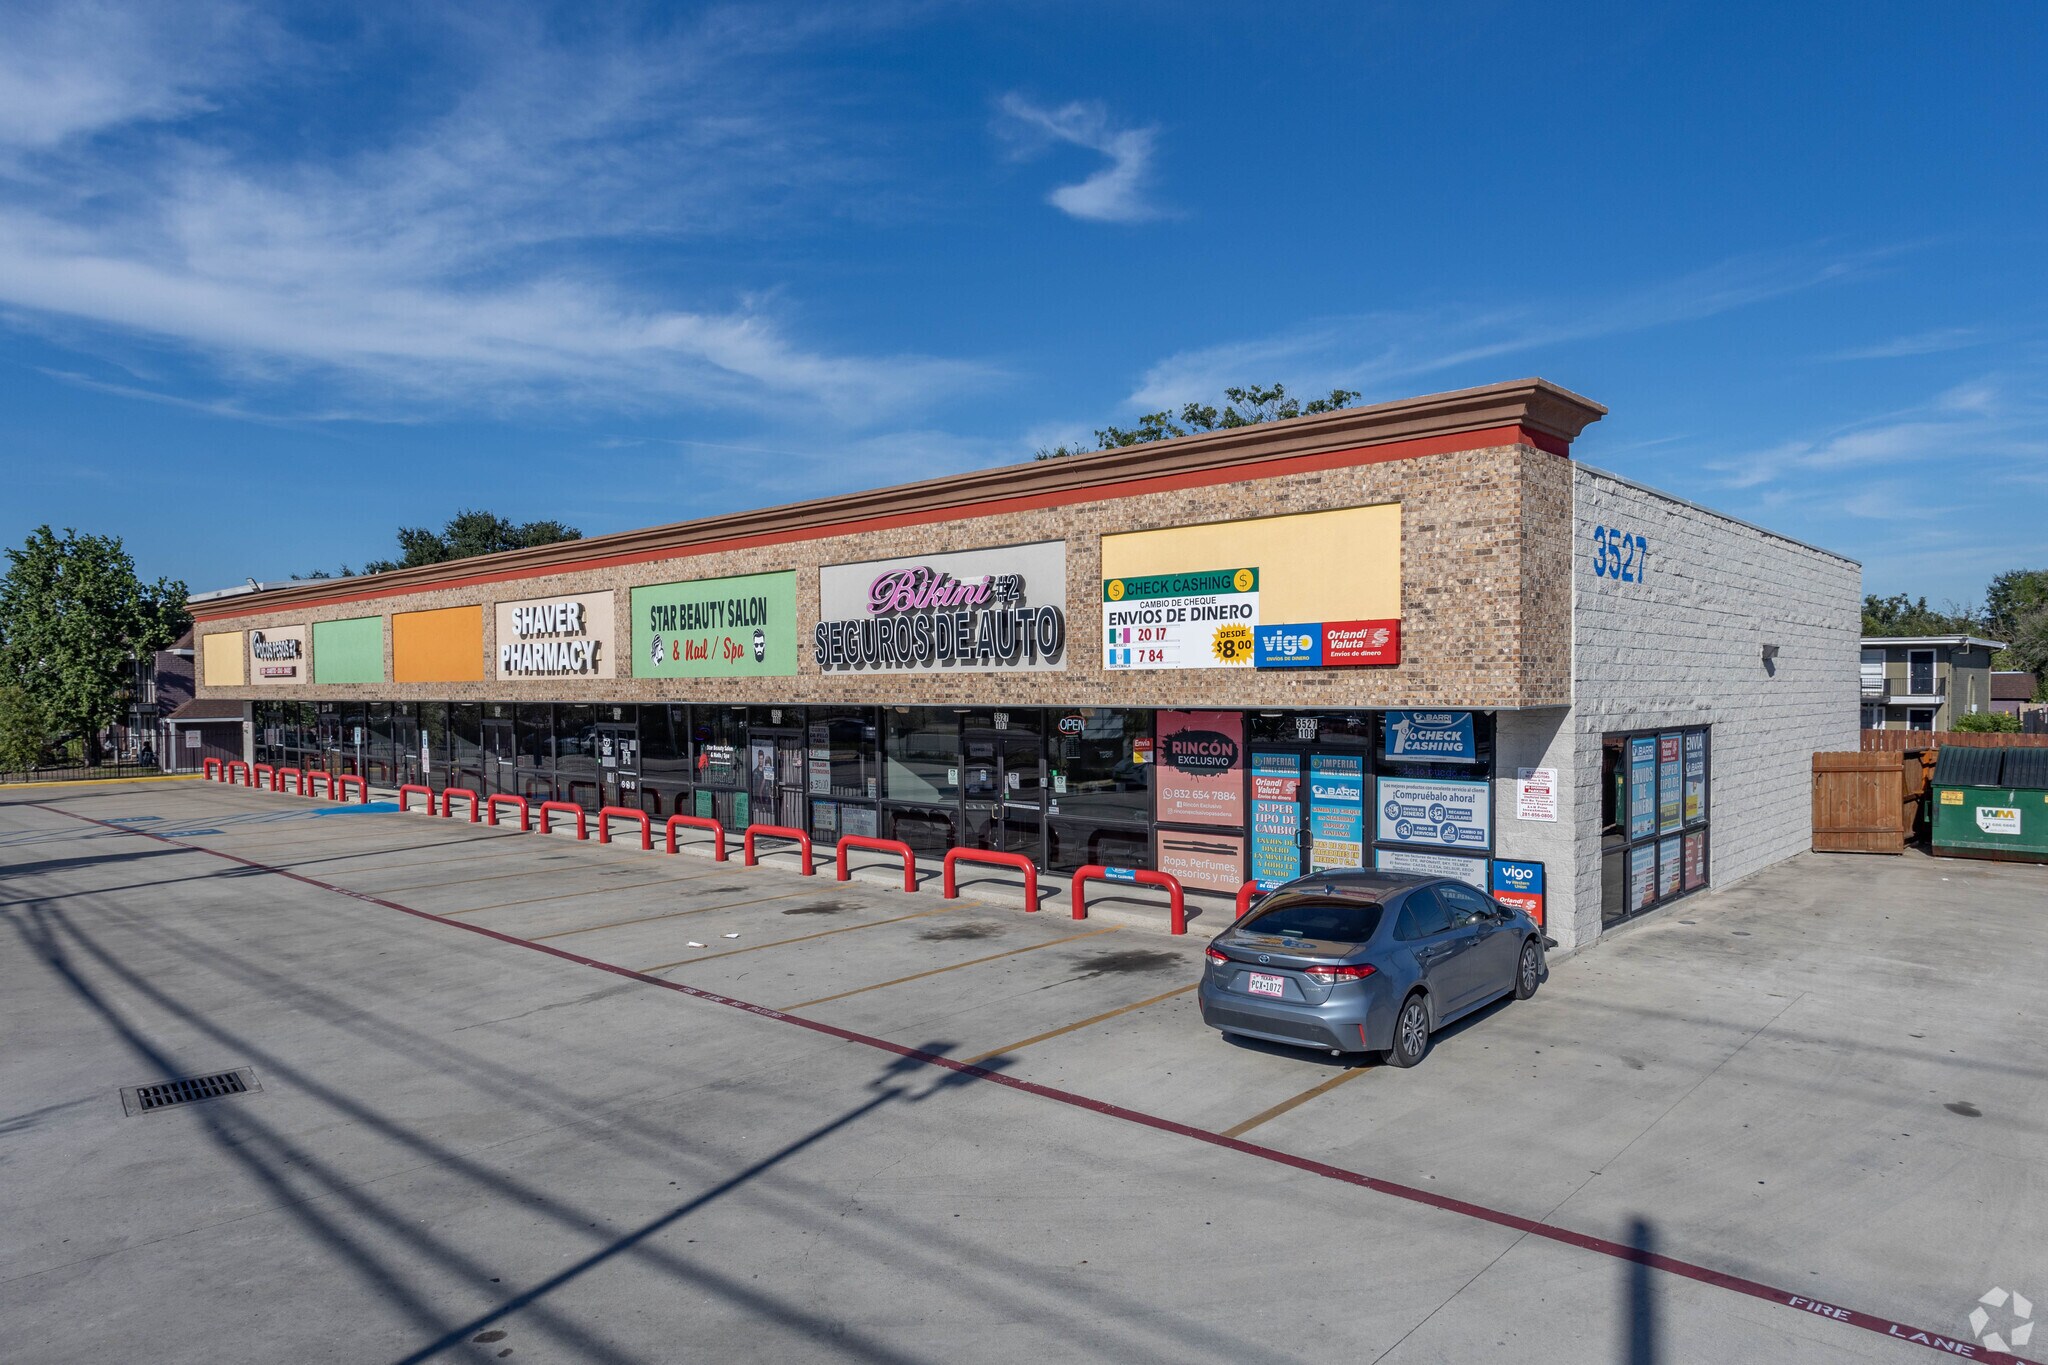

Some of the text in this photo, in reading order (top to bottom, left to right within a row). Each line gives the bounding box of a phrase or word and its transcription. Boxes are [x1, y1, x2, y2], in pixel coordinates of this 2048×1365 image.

[1593, 525, 1647, 584] 3527
[866, 565, 1019, 614] Bikini #2
[1127, 575, 1231, 596] CHECK CASHING
[1140, 596, 1216, 609] CAMBIO DE CHEQUE
[511, 602, 580, 635] SHAVER
[650, 596, 767, 631] STAR BEAUTY SALON
[1109, 603, 1253, 626] ENVIOS DE DINERO
[814, 605, 1059, 665] SEGUROS DE AUTO
[1220, 630, 1246, 639] DESDE
[1327, 629, 1368, 640] Orlandi
[1263, 630, 1313, 655] vigo
[1331, 640, 1364, 649] Valuta
[501, 640, 596, 671] PHARMACY
[672, 639, 679, 661] &
[723, 636, 744, 664] Spa
[1060, 718, 1085, 731] OPEN
[1296, 719, 1317, 729] 3527
[1299, 729, 1315, 738] 108
[1418, 731, 1463, 741] CHECK
[1172, 740, 1232, 756] RINCÓN
[1404, 741, 1464, 751] CASHING
[1638, 745, 1654, 756] BARRI
[1178, 755, 1228, 766] EXCLUSIVO
[1263, 757, 1296, 766] IMPERIAL
[1322, 758, 1358, 769] IMPERIAL
[1660, 763, 1678, 777] SUPER
[1255, 778, 1282, 787] Orlandi
[1173, 789, 1236, 801] 832 654 7884
[1258, 786, 1280, 794] Valuta
[1327, 787, 1360, 797] BARRI
[1393, 789, 1475, 803] ¡Compruébalo ahora!
[1257, 803, 1293, 814] SUPER
[1981, 809, 2015, 818] WM
[1254, 813, 1297, 825] TIPO DE
[1255, 824, 1296, 836] CAMBIO
[1164, 855, 1238, 873] Ropa, Perfumes,
[1161, 866, 1240, 884] Accesorios y más
[1262, 869, 1290, 877] MUNDO
[1502, 865, 1533, 880] vigo
[1499, 897, 1523, 905] Orlandi
[1789, 1295, 1975, 1357] FIRE LANE
